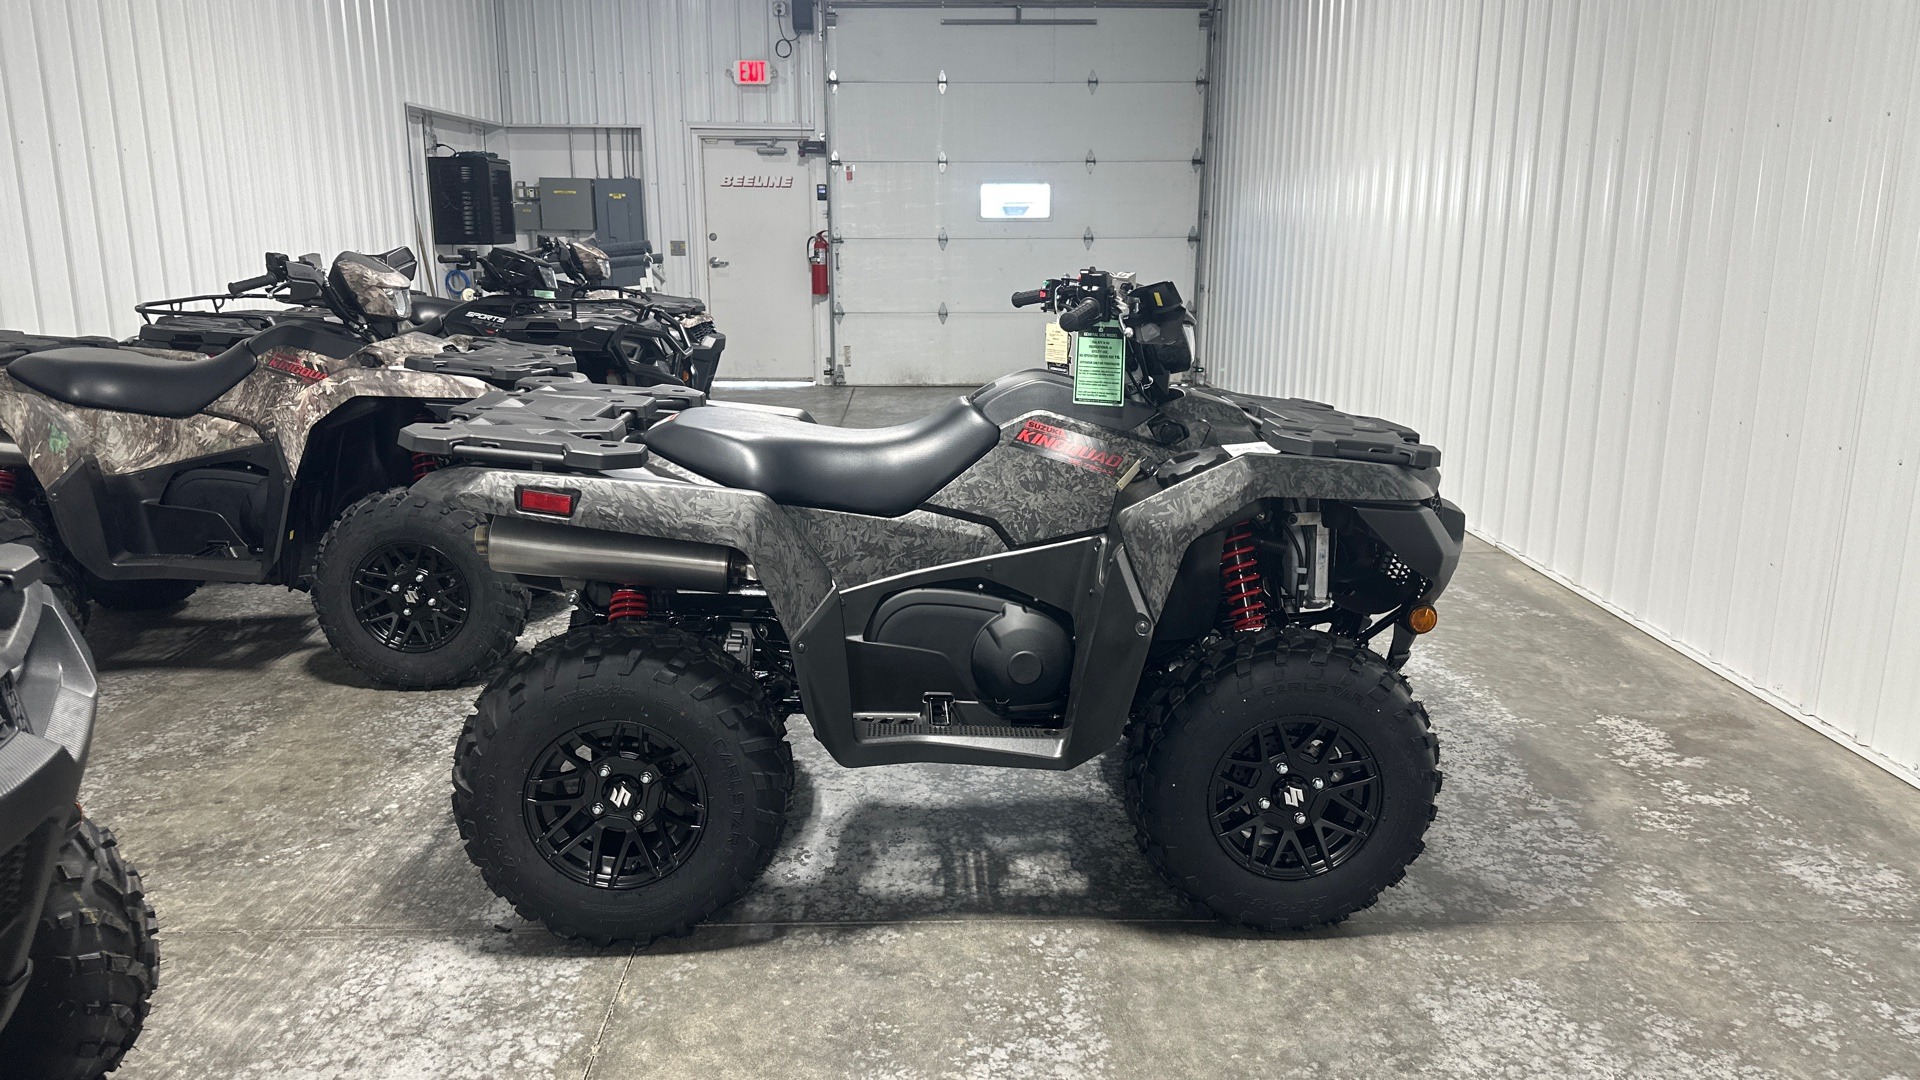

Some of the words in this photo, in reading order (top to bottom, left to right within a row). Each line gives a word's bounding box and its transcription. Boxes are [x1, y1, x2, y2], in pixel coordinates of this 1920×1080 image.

[740, 61, 765, 82] EXIT
[720, 175, 793, 188] BEELINE
[1028, 421, 1063, 436] SUZUKI
[1017, 429, 1124, 467] KINGQUAD
